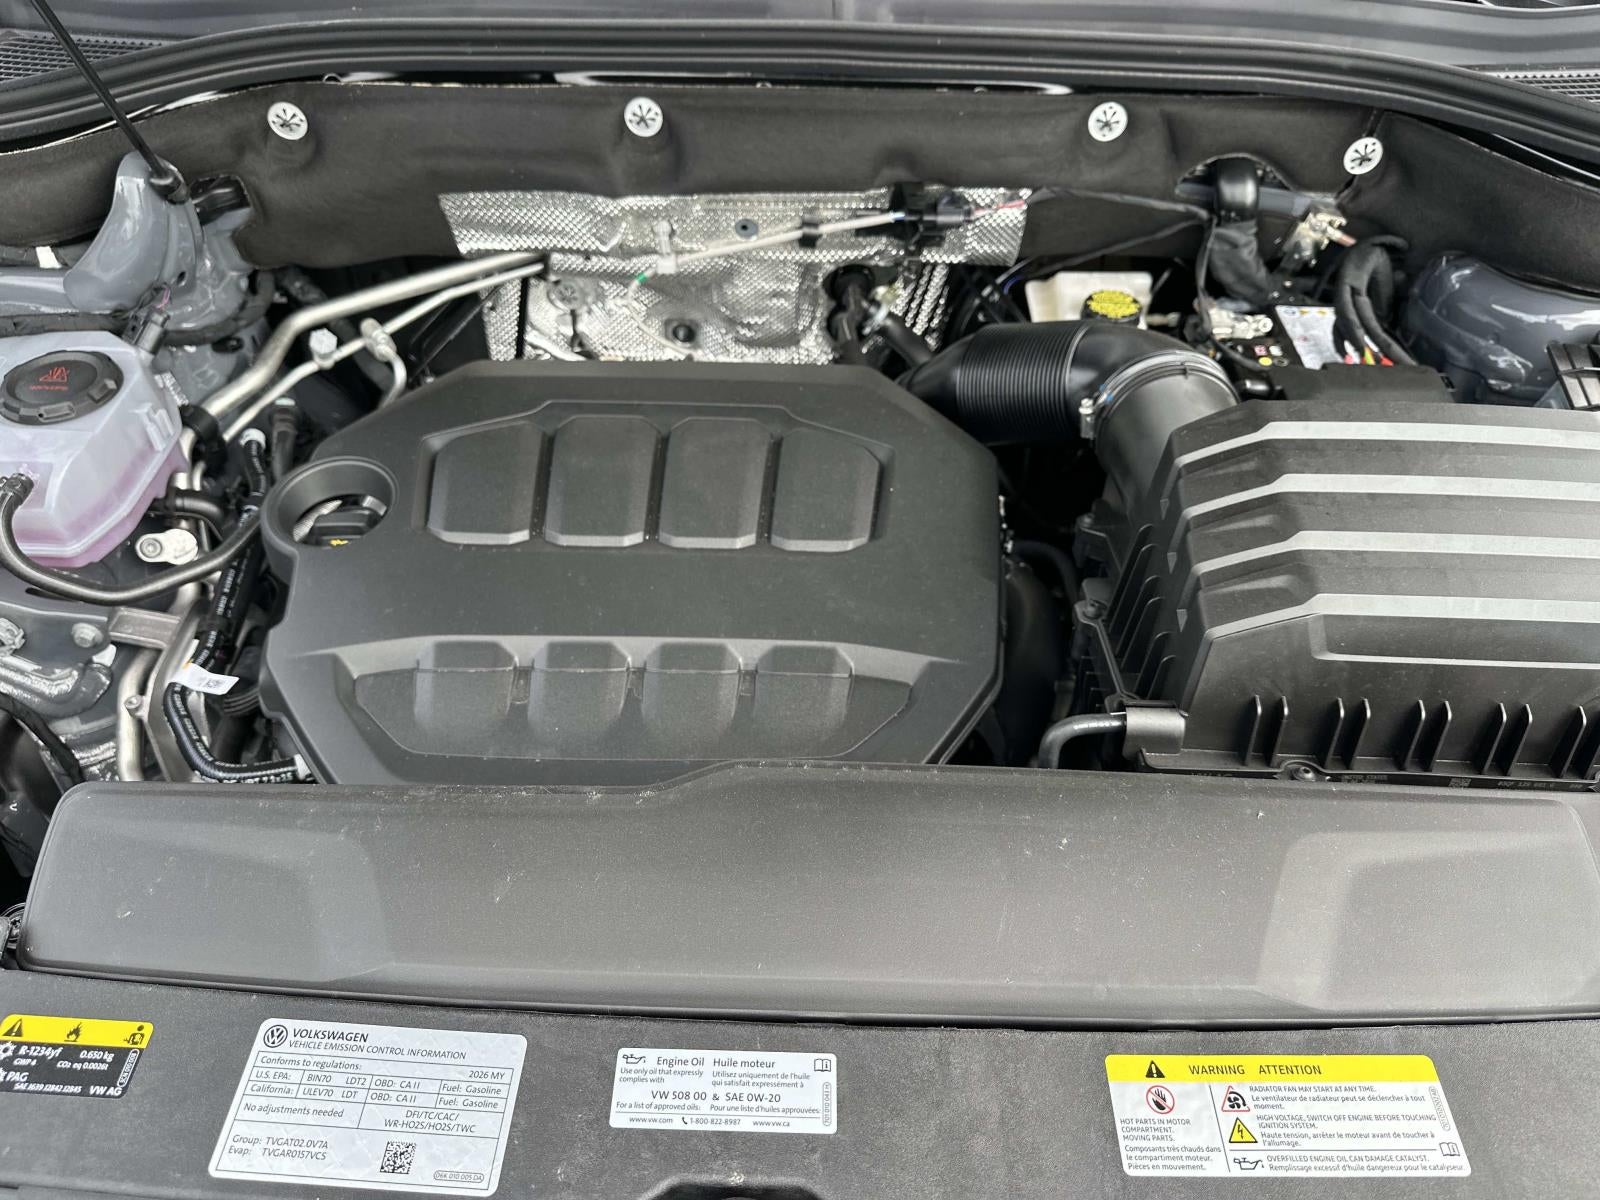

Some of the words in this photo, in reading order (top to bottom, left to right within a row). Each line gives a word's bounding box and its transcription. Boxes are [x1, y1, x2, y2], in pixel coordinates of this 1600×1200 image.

[293, 1028, 369, 1042] VOLKSWAGEN
[19, 1045, 63, 1058] R-1234yf
[289, 1040, 321, 1050] VEHICLE
[324, 1042, 365, 1052] EMISSION
[366, 1046, 405, 1056] CONTROL
[407, 1048, 467, 1059] INFORMATION
[80, 1050, 103, 1060] 0.650
[103, 1051, 115, 1062] kg
[72, 1062, 82, 1070] eq
[261, 1055, 300, 1066] Conforms
[302, 1058, 311, 1066] to
[312, 1059, 362, 1070] regulations:
[657, 1056, 689, 1068] Engine
[691, 1057, 705, 1066] Oil
[713, 1058, 738, 1068] Huile
[740, 1060, 775, 1069] moteur
[256, 1070, 271, 1079] U.S.
[273, 1071, 292, 1080] EPA:
[469, 1070, 489, 1079] 2026
[490, 1071, 506, 1080] MY
[634, 1068, 648, 1076] only
[673, 1068, 704, 1077] expressly
[1189, 1065, 1245, 1075] WARNING
[1259, 1065, 1322, 1075] ATTENTION
[6, 1071, 29, 1082] PAG
[307, 1073, 332, 1083] BIN70
[346, 1076, 367, 1086] LDT2
[619, 1076, 649, 1084] complies
[738, 1072, 779, 1080] uniquement
[14, 1082, 28, 1090] SAE
[374, 1078, 396, 1088] OBD:
[752, 1081, 798, 1089] expressément
[89, 1085, 107, 1095] VW
[107, 1086, 122, 1096] AG
[250, 1083, 294, 1094] California:
[302, 1087, 334, 1098] ULEV70
[442, 1083, 462, 1093] Fuel:
[465, 1084, 502, 1095] Gasoline
[341, 1090, 358, 1099] LDT
[370, 1092, 392, 1101] OBD:
[651, 1090, 670, 1100] VW
[672, 1091, 691, 1100] 508
[693, 1091, 707, 1101] 00
[712, 1093, 720, 1101] &
[725, 1093, 744, 1102] SAE
[747, 1093, 781, 1103] 0W-20
[438, 1097, 458, 1107] Fuel:
[462, 1098, 499, 1109] Gasoline
[616, 1101, 627, 1109] For
[634, 1101, 644, 1109] list
[654, 1102, 686, 1111] approved
[740, 1104, 754, 1112] liste
[243, 1102, 255, 1112] No
[257, 1103, 311, 1116] adjustments
[311, 1107, 345, 1118] needed
[405, 1110, 460, 1122] DFI/TC/CAC/
[690, 1117, 741, 1126] 1-800-822-8987
[232, 1134, 262, 1145] Group:
[266, 1136, 329, 1149] TVGAT02.0V7A
[228, 1145, 252, 1156] Evap:
[1124, 1145, 1165, 1153] Composants
[1181, 1145, 1204, 1153] chauds
[1134, 1154, 1184, 1162] compartiment
[1269, 1164, 1313, 1172] Remplissage
[1366, 1164, 1402, 1173] dangereux
